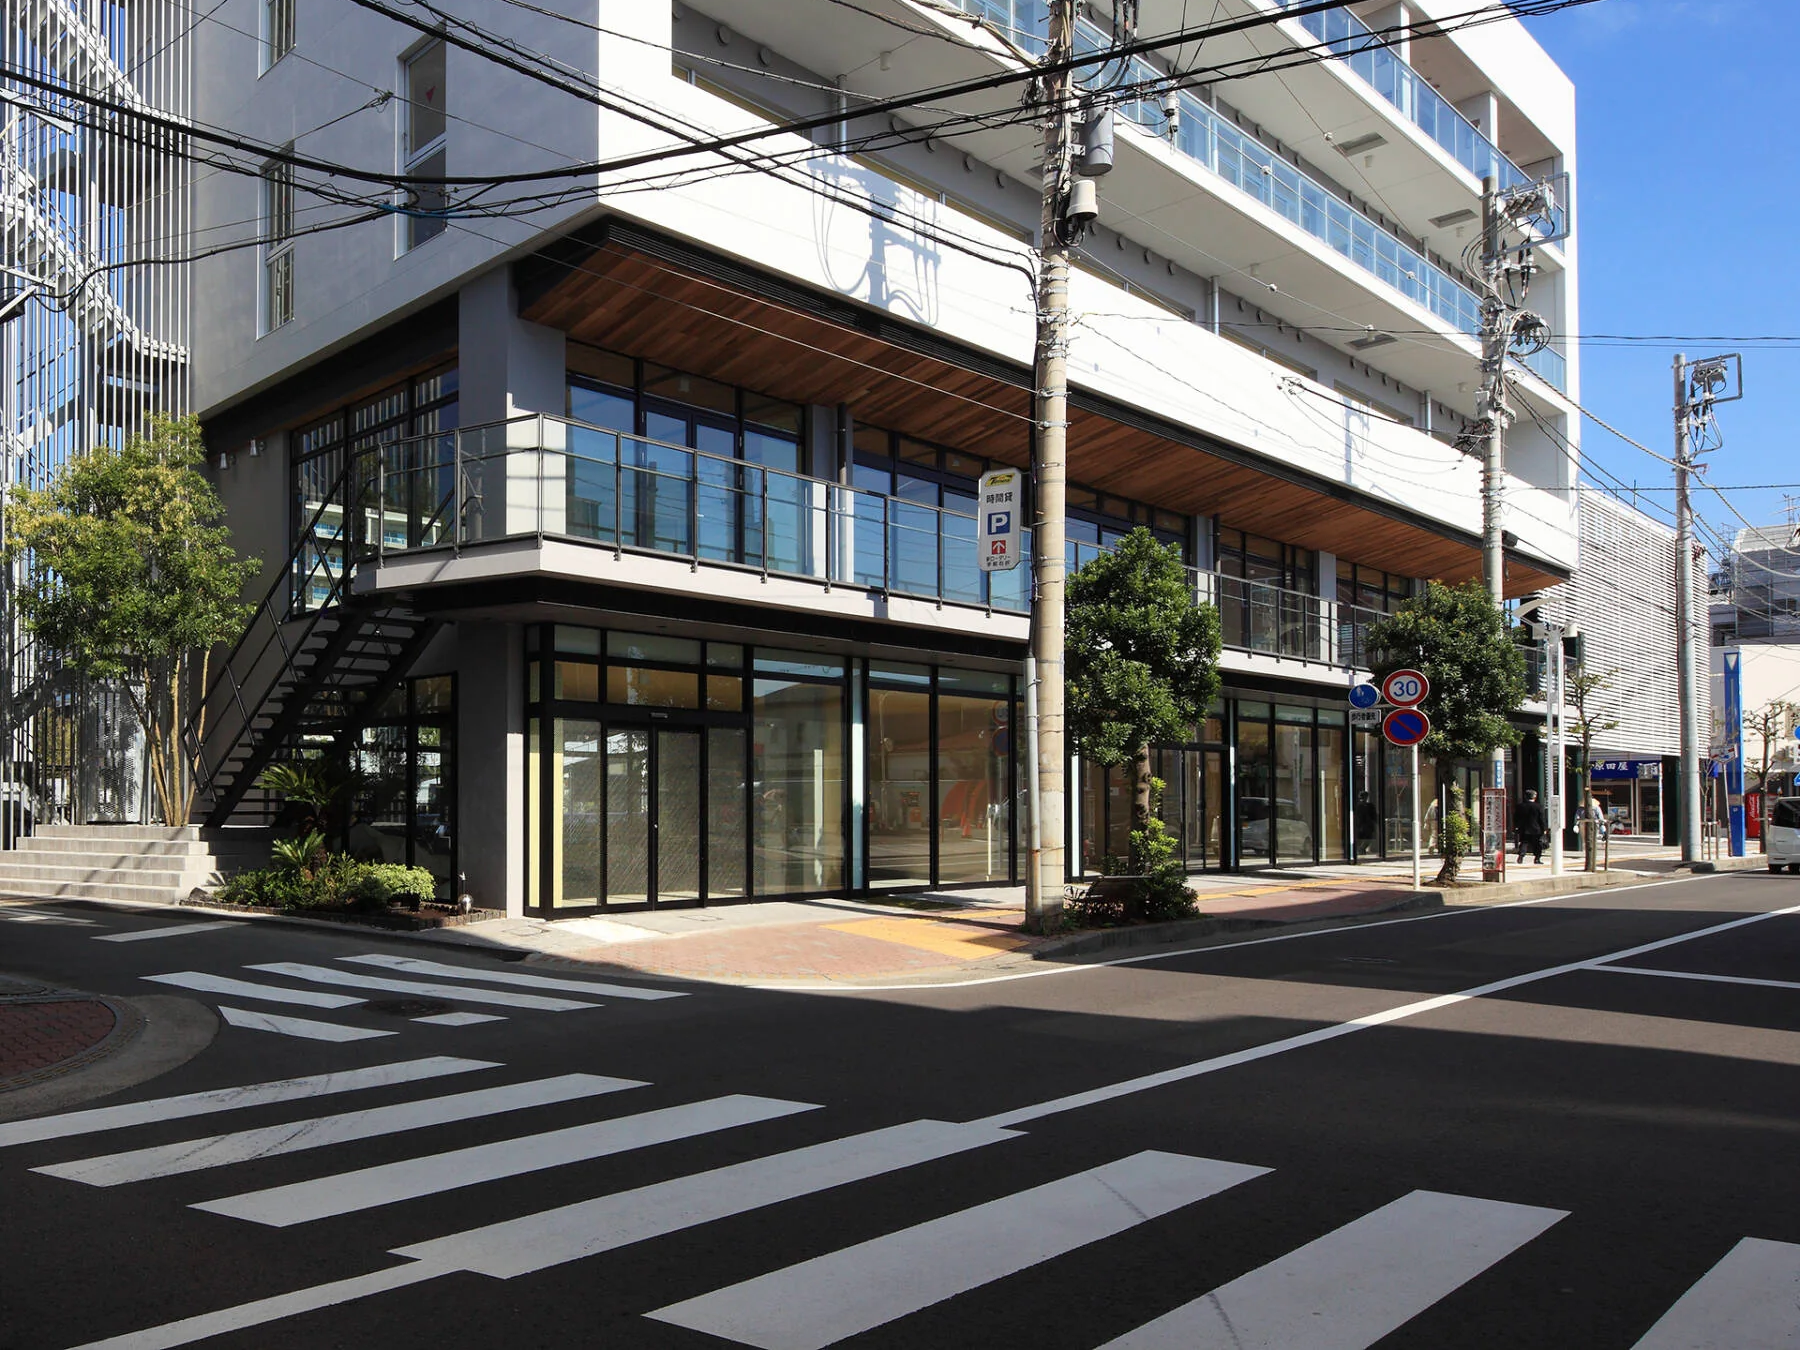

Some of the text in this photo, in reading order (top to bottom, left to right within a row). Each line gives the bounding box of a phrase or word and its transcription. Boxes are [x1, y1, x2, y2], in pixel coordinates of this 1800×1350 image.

[986, 492, 1013, 504] 時間貸
[992, 514, 1008, 533] P
[1394, 680, 1418, 697] 30
[1591, 761, 1629, 771] 原田屋
